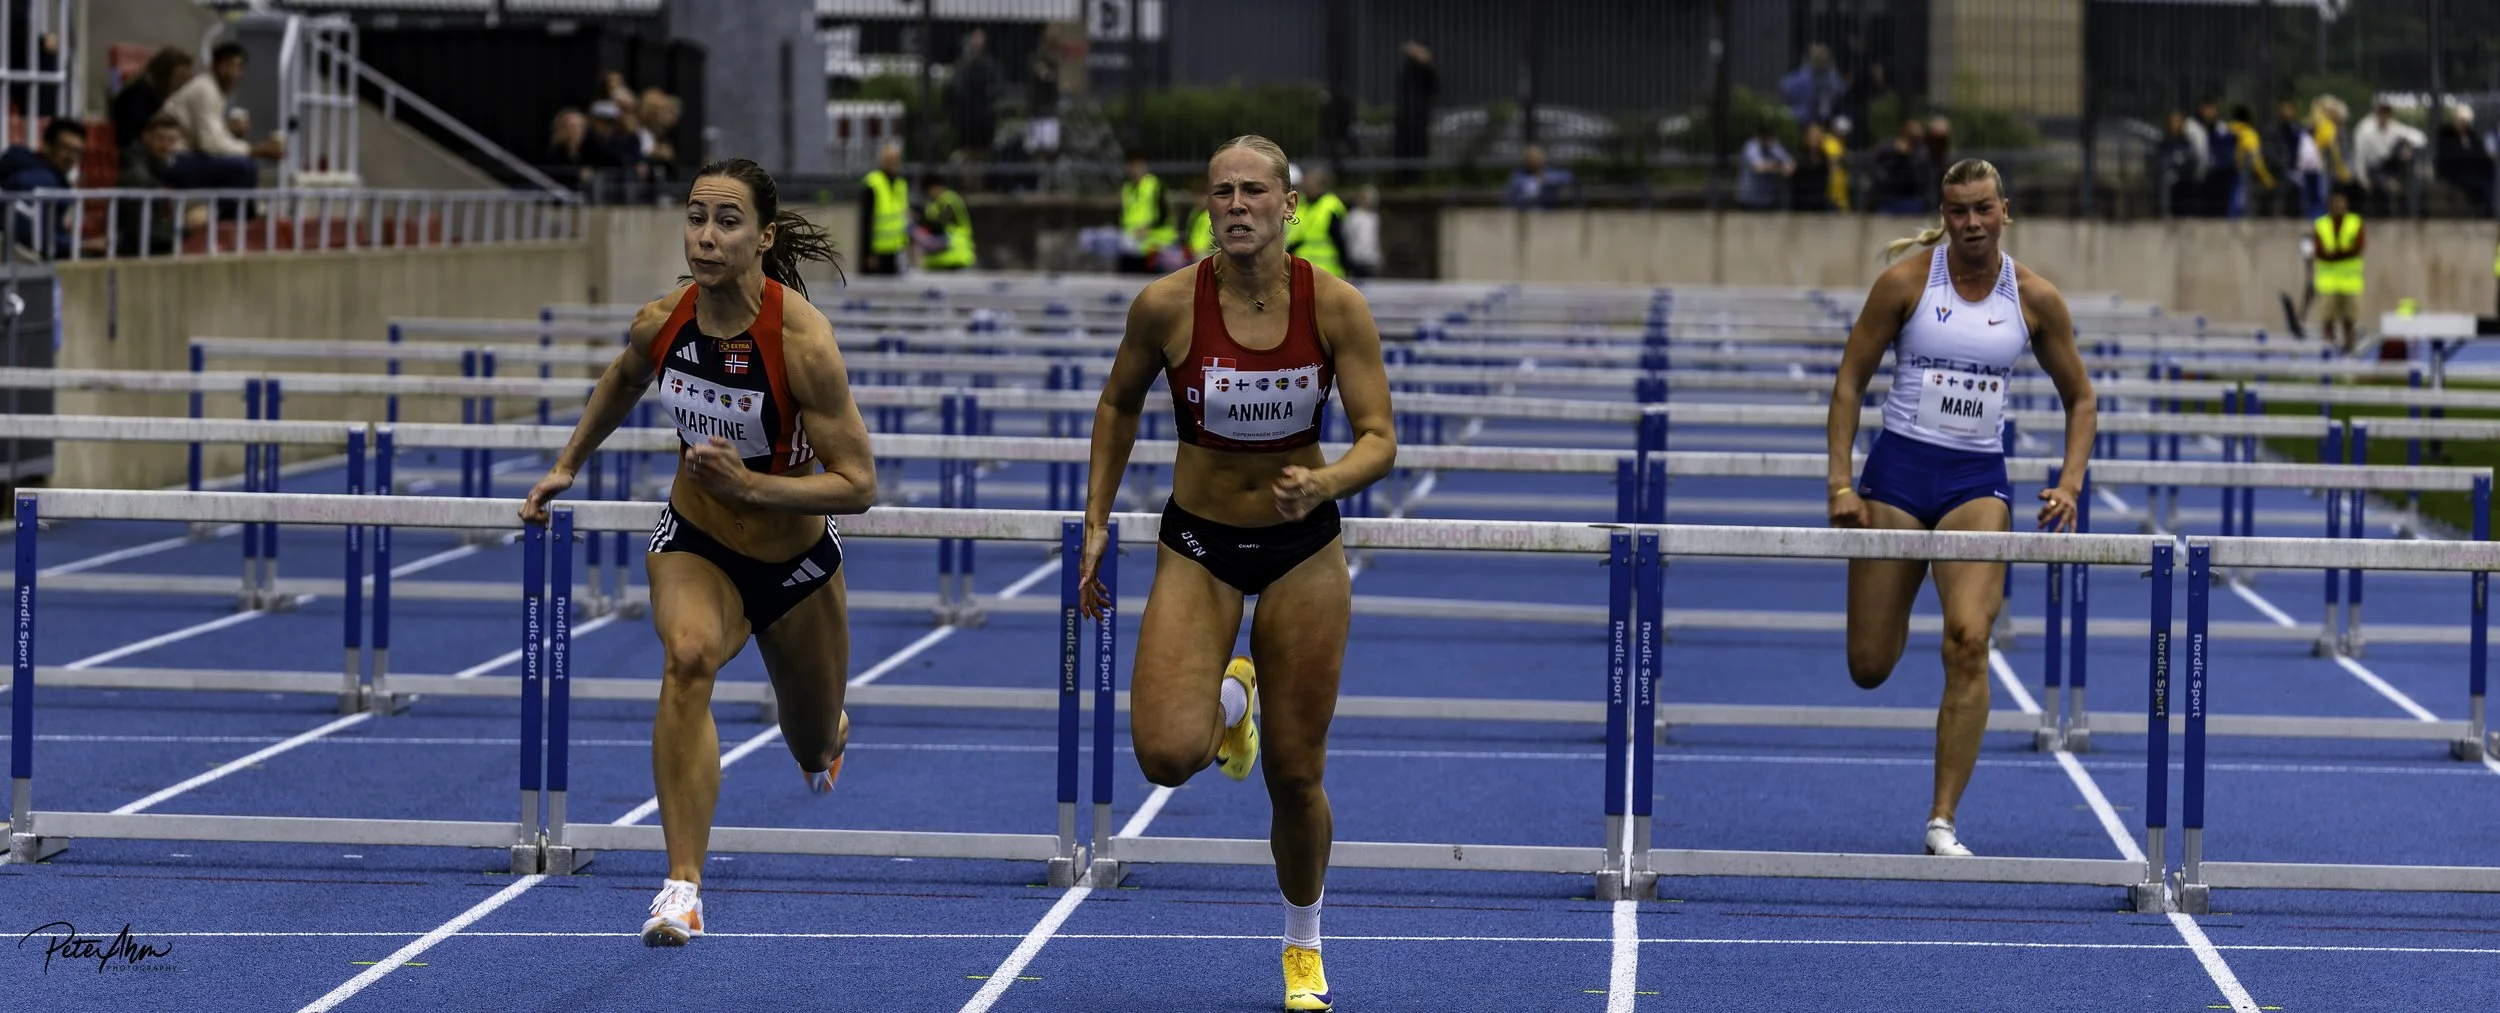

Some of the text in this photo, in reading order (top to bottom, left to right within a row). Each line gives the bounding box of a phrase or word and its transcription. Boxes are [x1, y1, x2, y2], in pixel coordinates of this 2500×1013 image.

[674, 406, 747, 441] MARTINE
[1228, 401, 1294, 422] ANNIKA
[1940, 396, 1984, 418] MARÍA
[1181, 531, 1207, 557] DEN
[18, 585, 30, 669] nordic Sport
[527, 597, 539, 680] nordic Sport
[554, 597, 566, 680] nordic Sport
[1064, 608, 1076, 691] nordic Sport
[1100, 608, 1112, 691] nordic Sport
[1612, 621, 1625, 704] nordic Sport
[1640, 622, 1652, 705] nordic Sport
[2157, 633, 2167, 677] nordic
[2191, 634, 2203, 718] nordic Sport
